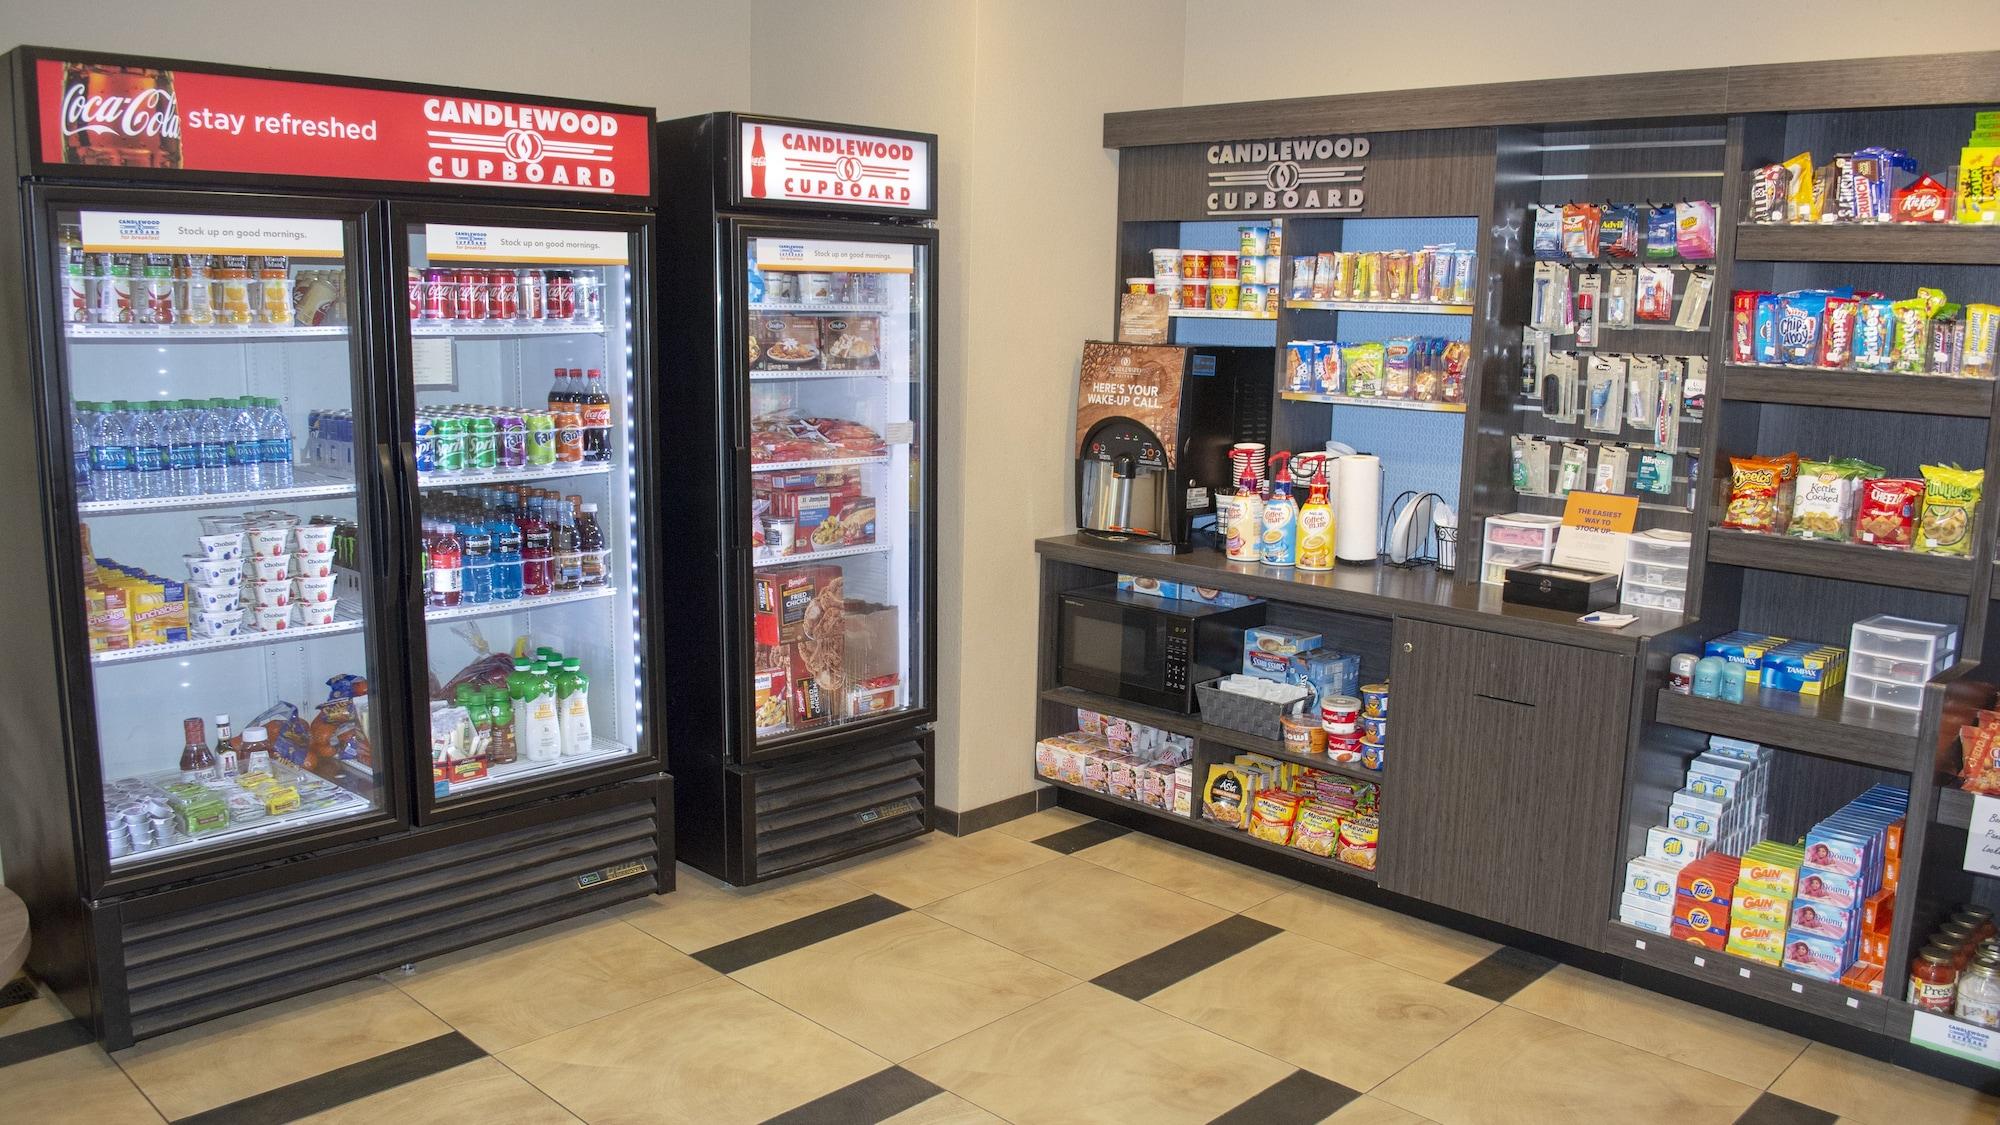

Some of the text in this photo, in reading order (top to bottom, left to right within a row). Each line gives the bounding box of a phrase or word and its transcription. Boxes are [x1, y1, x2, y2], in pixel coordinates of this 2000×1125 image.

[188, 107, 377, 141] stay refreshed
[423, 98, 618, 137] CANDLEWOOD
[782, 133, 913, 161] CANDLEWOOD
[1207, 137, 1370, 164] CANDLEWOOD
[428, 156, 615, 187] CUPBOARD
[784, 178, 911, 201] CUPBOARD
[1206, 188, 1364, 210] CUPBOARD
[1856, 176, 1871, 219] CRUNCH
[1601, 220, 1624, 229] Advil
[178, 226, 307, 240] Stock up on good mornings.
[500, 238, 521, 247] Stock
[523, 240, 533, 248] up
[545, 239, 565, 249] good
[566, 241, 600, 250] mornings.
[849, 251, 864, 259] good
[1092, 382, 1159, 397] HERE'S YOUR
[1087, 393, 1164, 409] WAKE-UP CALL.
[1733, 469, 1771, 488] Cheetos
[1810, 482, 1837, 493] Kettle
[1805, 491, 1839, 503] Cooked
[1578, 507, 1622, 519] THE EASIEST
[1575, 525, 1599, 533] STOCK
[88, 610, 125, 625] chables
[134, 602, 184, 622] Lunchables
[1727, 654, 1756, 666] TAMPAX
[1786, 666, 1817, 676] TAMPAX
[1663, 840, 1682, 855] all
[1750, 867, 1781, 880] GAIN
[1693, 884, 1713, 895] Tide
[1743, 896, 1774, 909] GAIN
[1690, 913, 1709, 925] Tide
[1740, 926, 1771, 940] GAIN
[1948, 1023, 1990, 1039] CANDLEWOOD
